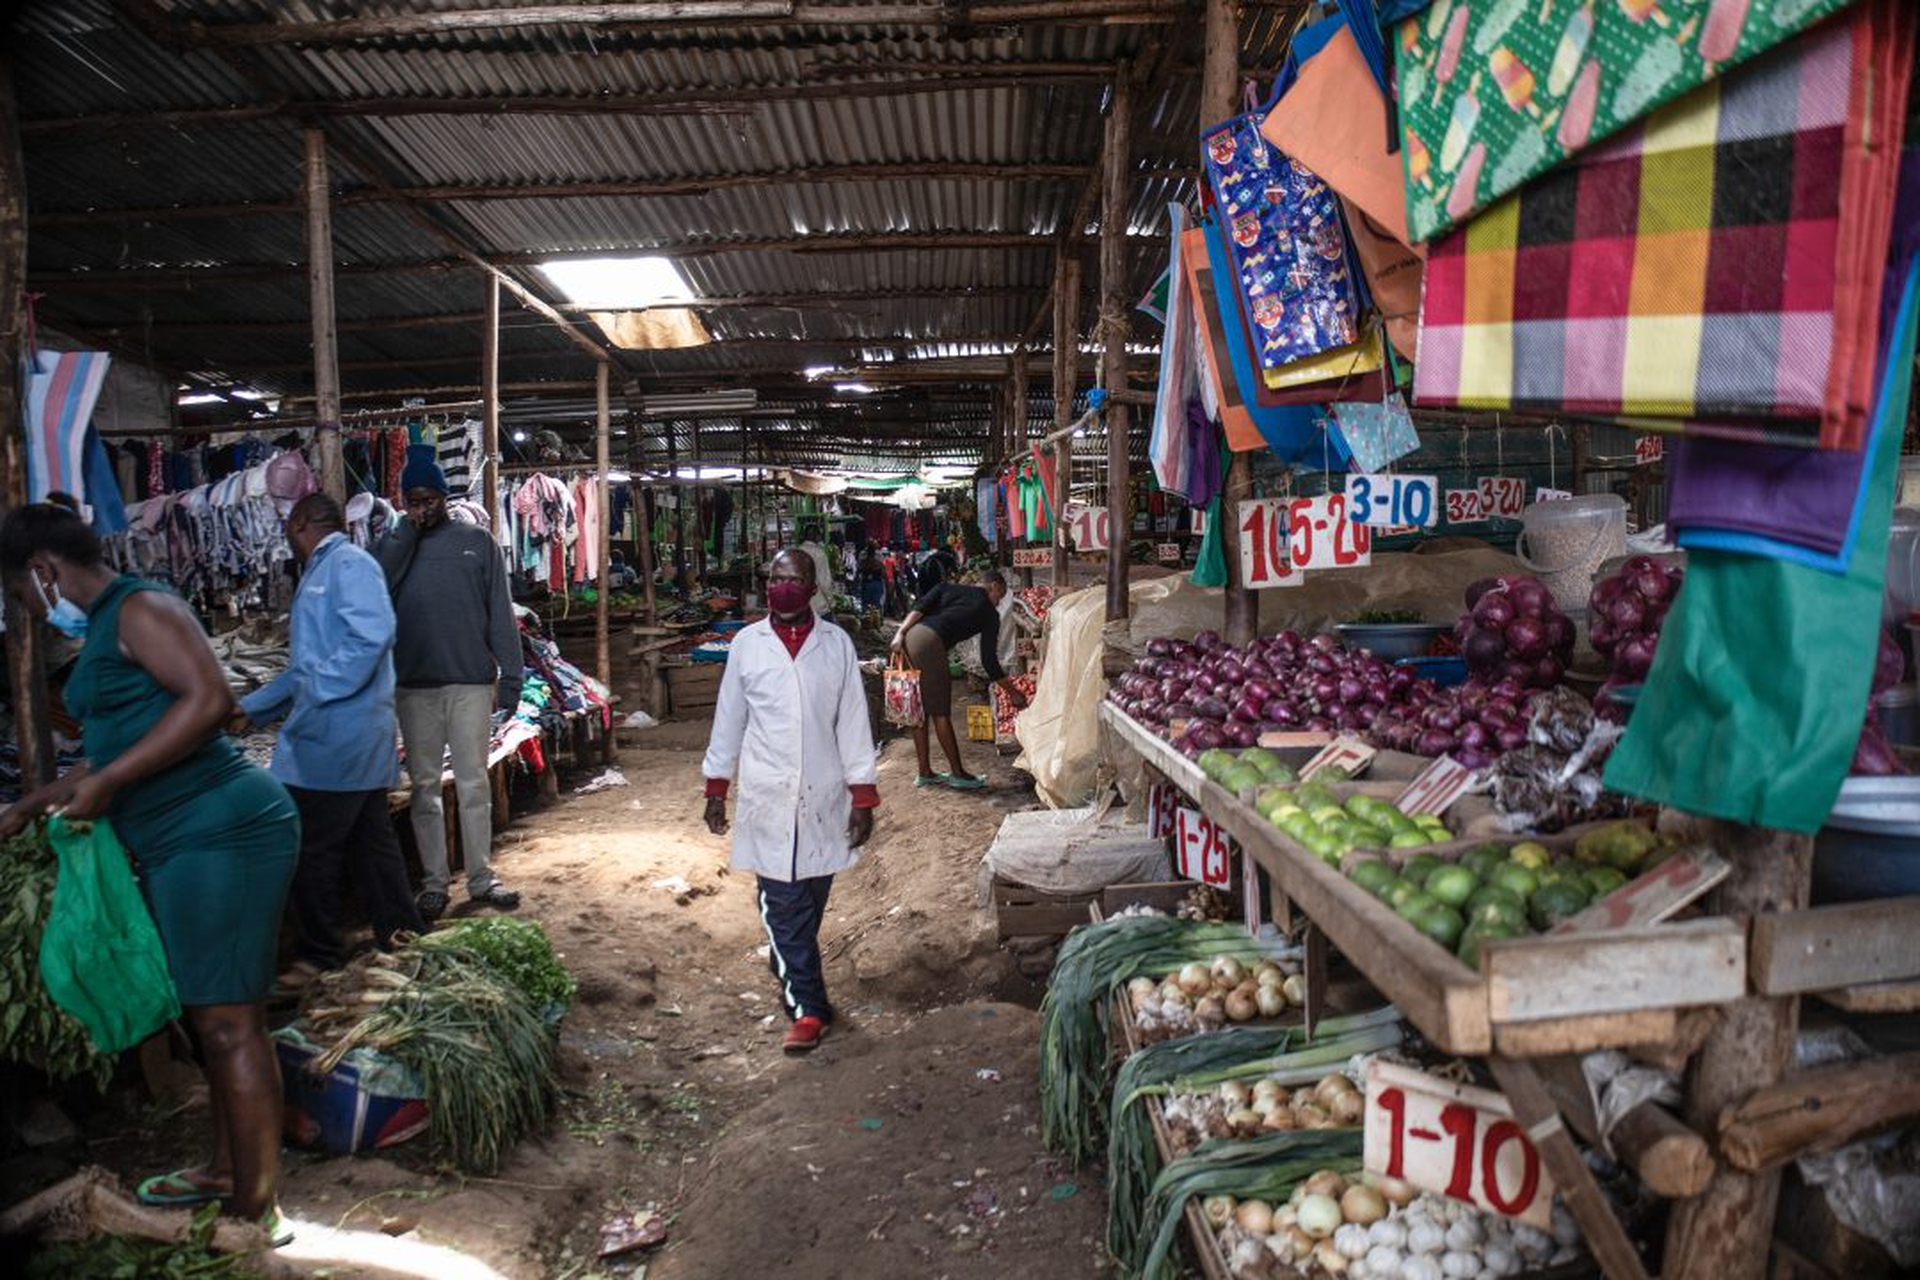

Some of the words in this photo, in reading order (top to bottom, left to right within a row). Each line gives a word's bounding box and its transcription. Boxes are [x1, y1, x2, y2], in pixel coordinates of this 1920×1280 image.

[1350, 476, 1432, 527] 3-10
[1479, 478, 1523, 516] 3-20
[1178, 810, 1228, 884] 1-25
[1377, 1086, 1541, 1216] 1-10
